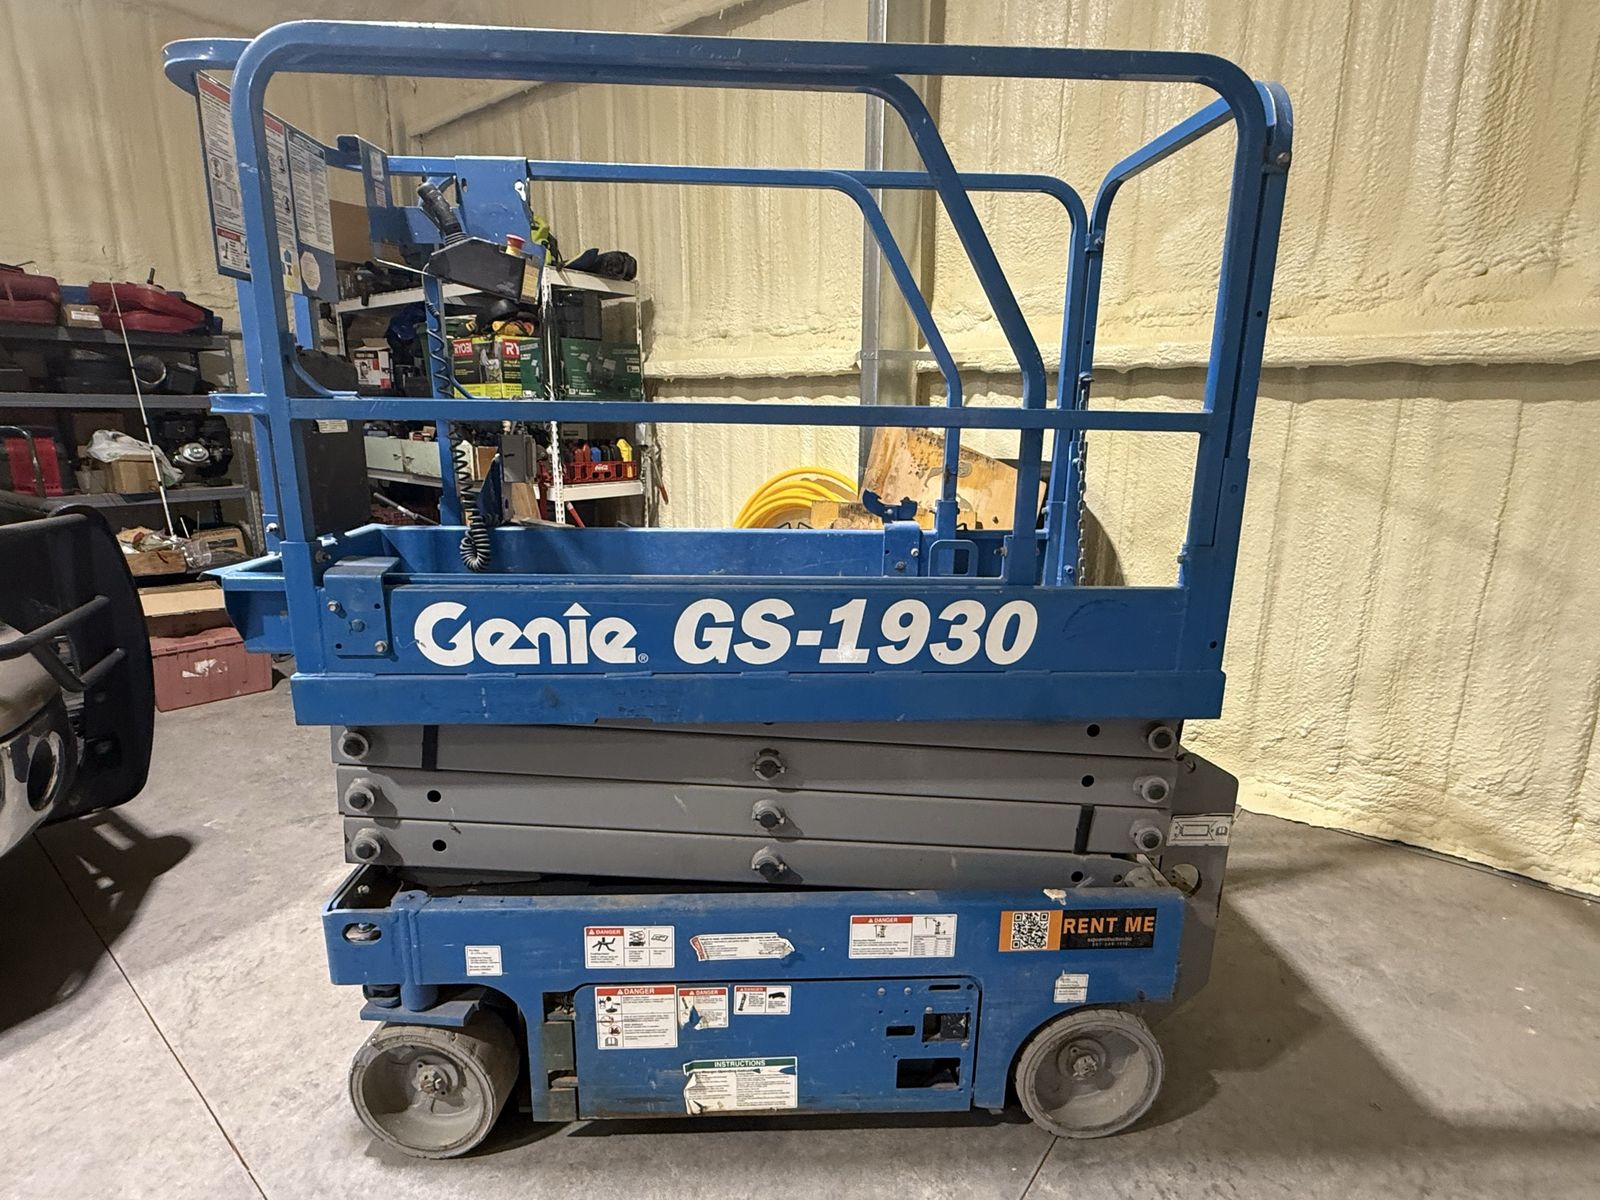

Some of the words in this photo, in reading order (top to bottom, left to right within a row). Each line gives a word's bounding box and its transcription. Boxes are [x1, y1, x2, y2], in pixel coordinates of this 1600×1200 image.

[453, 342, 473, 354] RYOBI
[673, 598, 1039, 666] GS-1930
[1063, 917, 1119, 935] RENT
[1124, 915, 1156, 933] ME
[714, 1059, 766, 1068] INSTRUCTIONS
